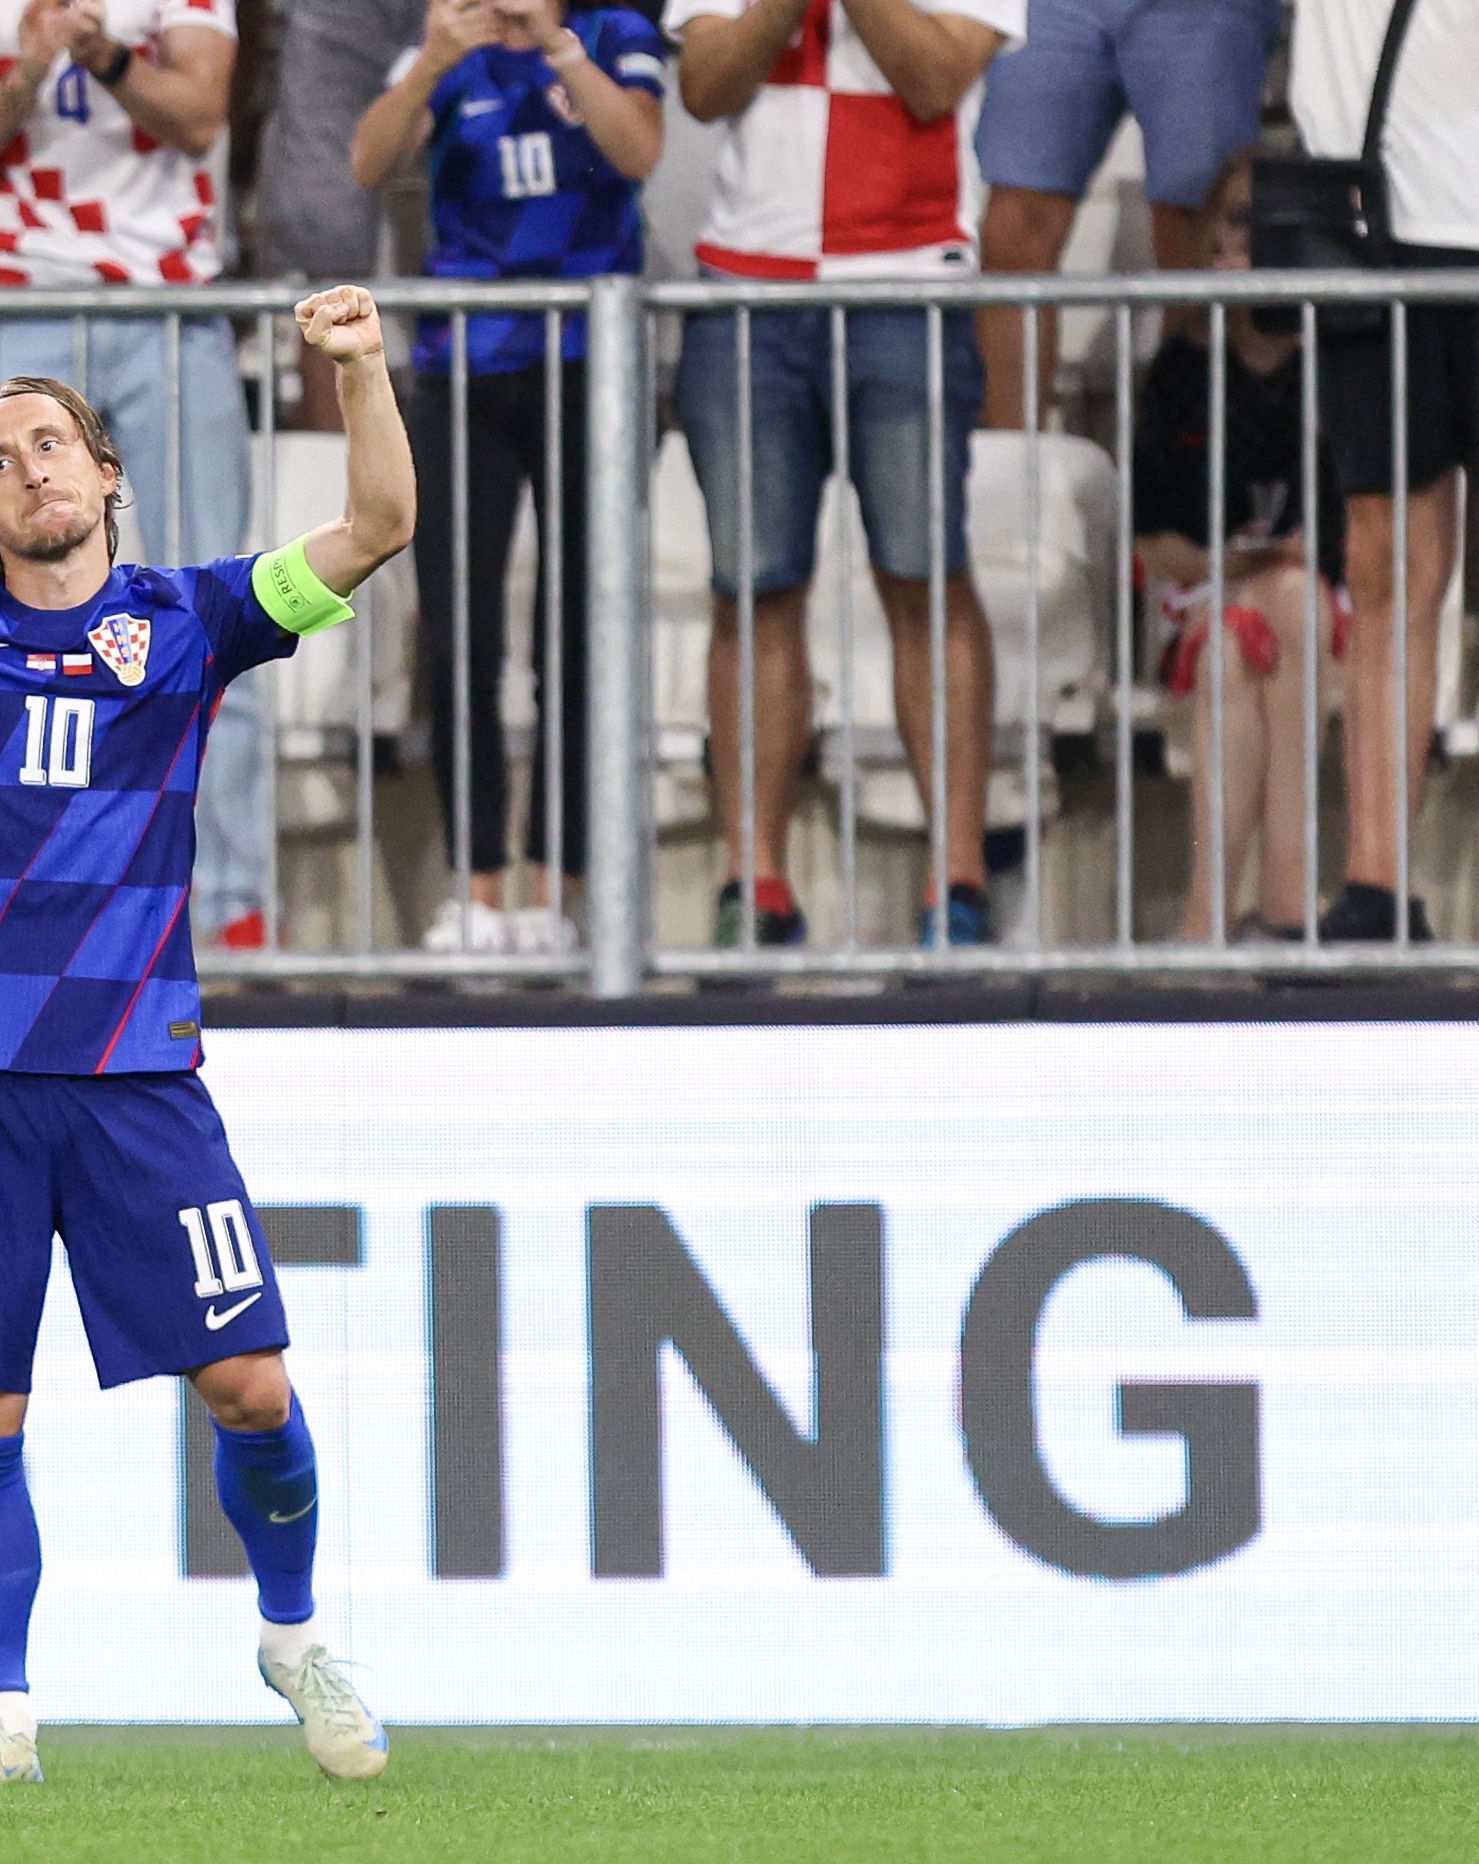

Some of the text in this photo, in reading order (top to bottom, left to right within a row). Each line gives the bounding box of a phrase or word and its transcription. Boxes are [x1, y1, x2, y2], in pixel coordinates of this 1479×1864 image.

[497, 132, 556, 199] 10
[19, 695, 95, 788] 10
[178, 1199, 264, 1298] 10
